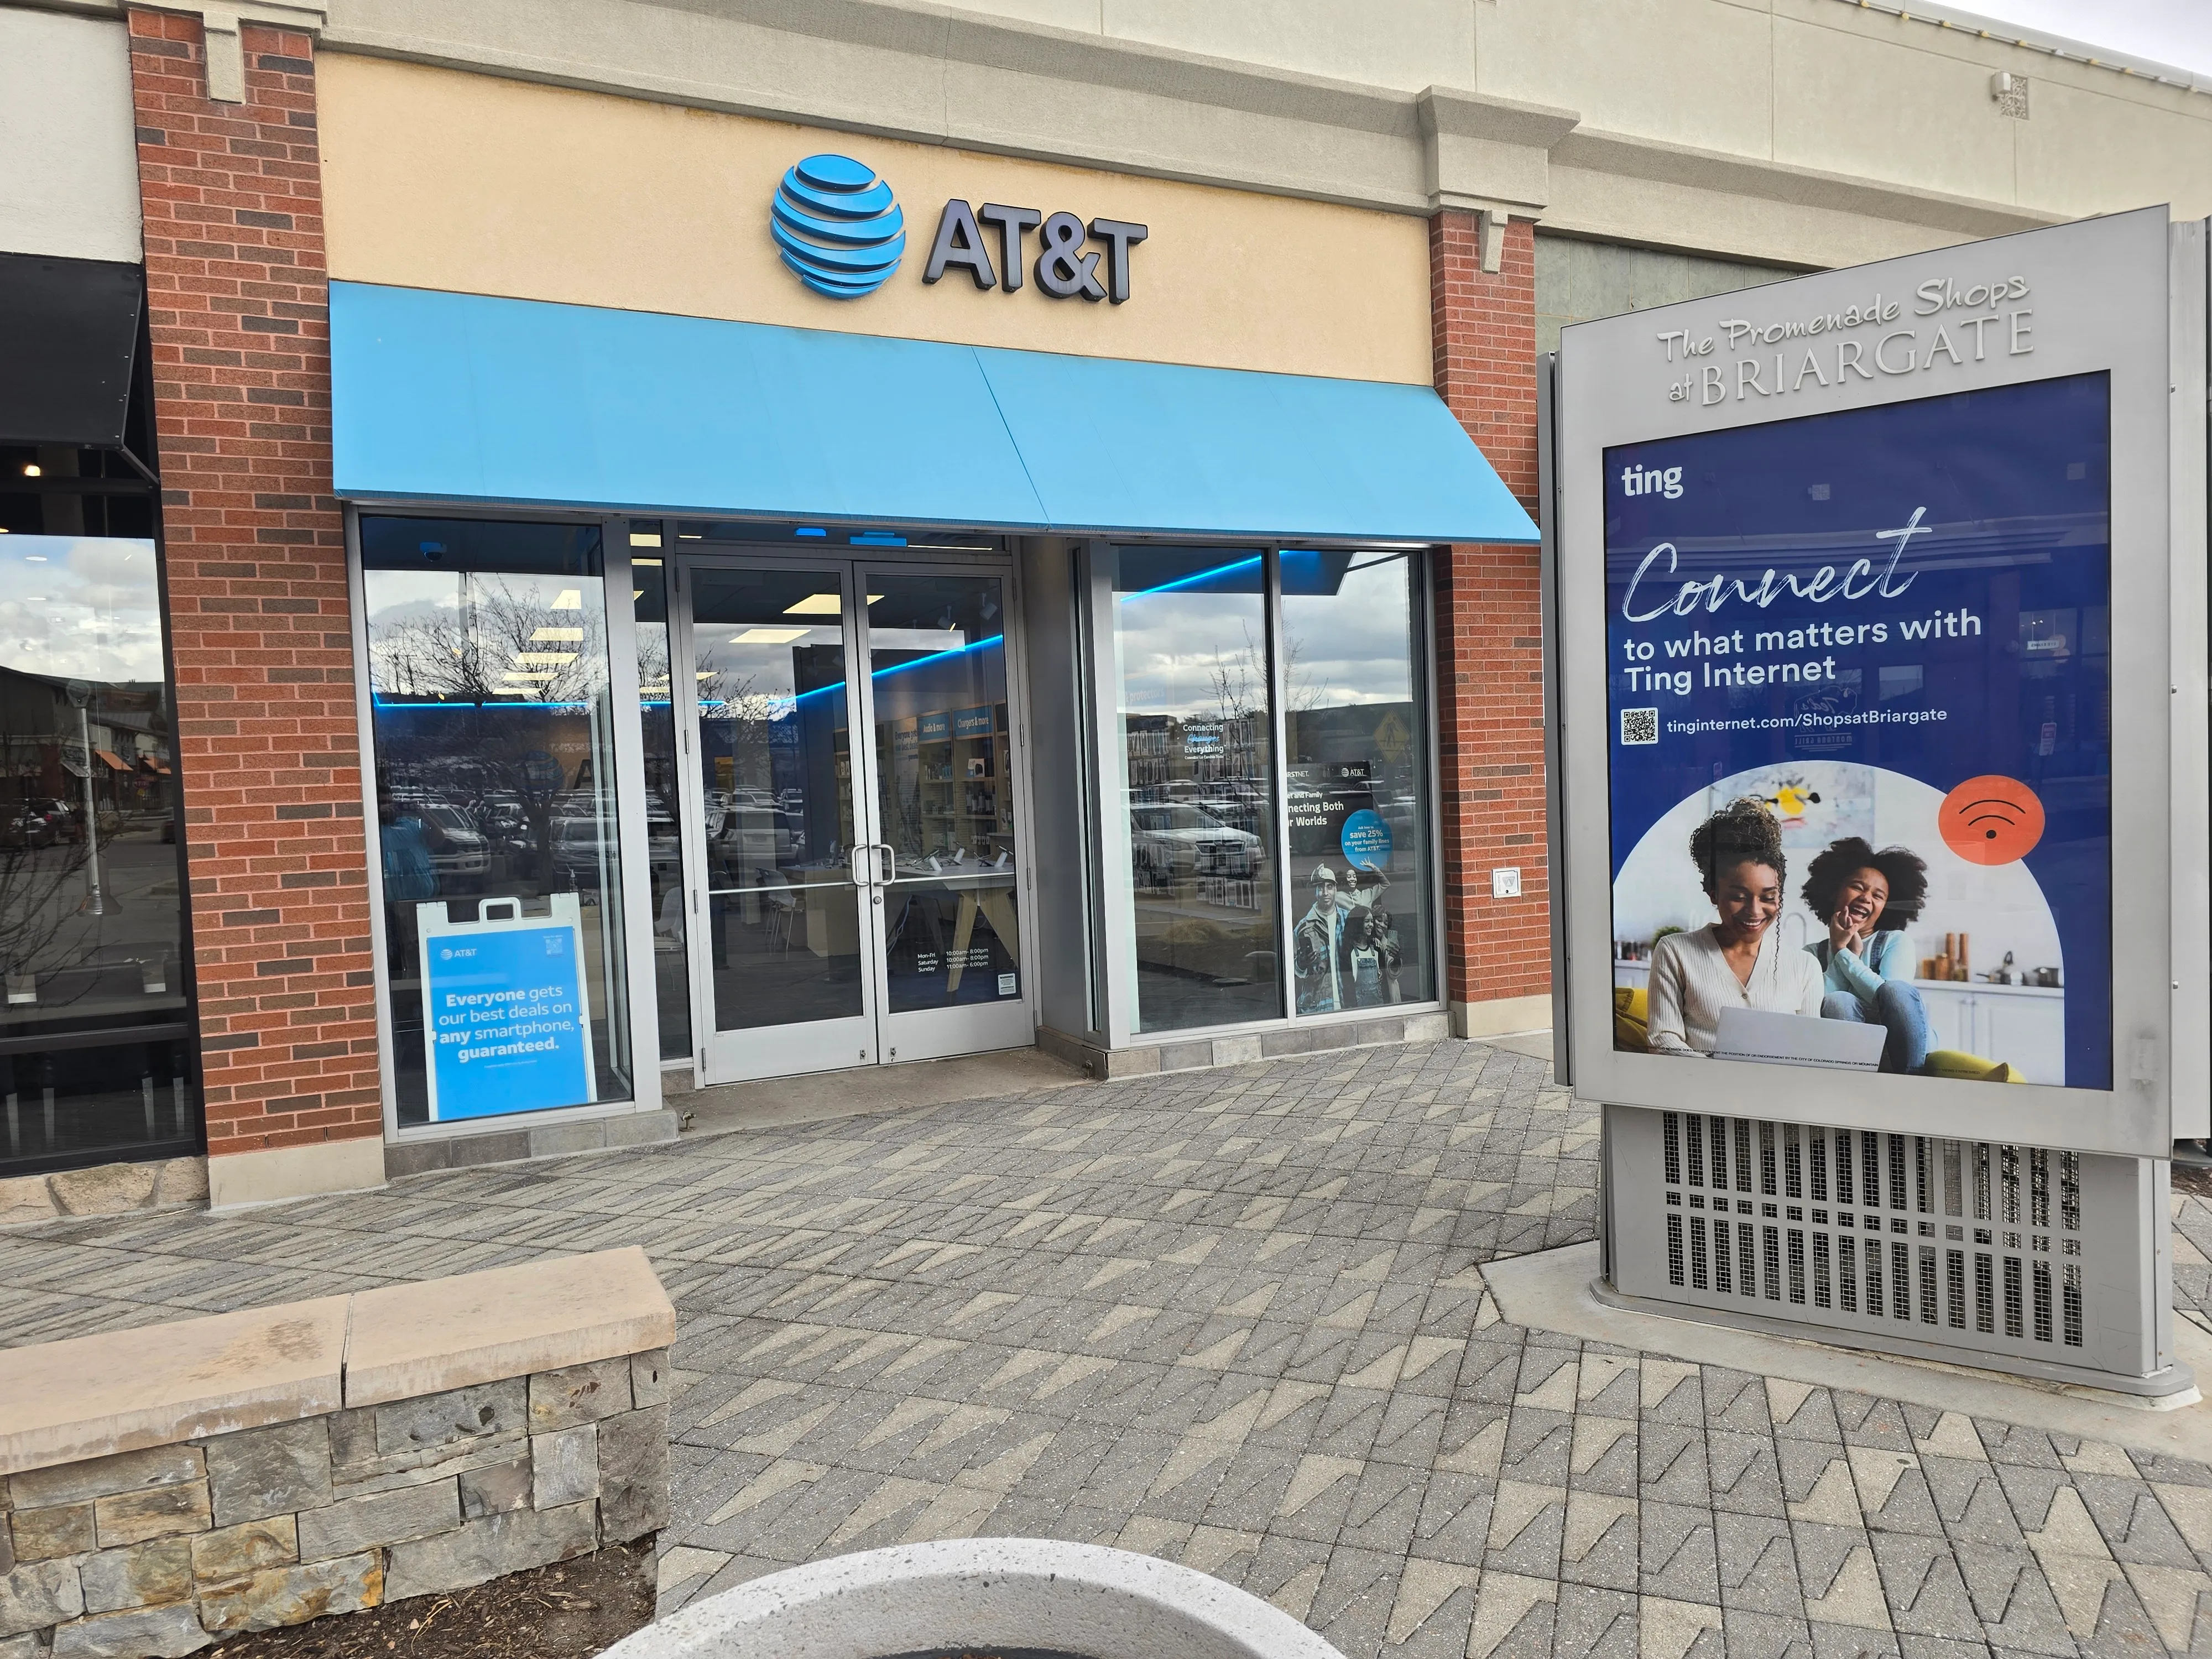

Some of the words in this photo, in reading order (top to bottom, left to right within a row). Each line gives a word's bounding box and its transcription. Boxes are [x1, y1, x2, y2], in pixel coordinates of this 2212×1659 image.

[922, 199, 1147, 304] AT&T
[1657, 329, 1714, 361] The
[1719, 294, 1900, 349] Promenade
[1914, 276, 2030, 316] Shops
[1669, 373, 1693, 402] at
[1702, 309, 2034, 405] BRIARGATE
[1621, 464, 1683, 499] ting
[1622, 506, 1933, 623] Connect
[1624, 638, 1655, 661] to
[1664, 629, 1744, 658] what
[1756, 620, 1888, 651] matters
[1899, 608, 1981, 640] with
[1624, 666, 1692, 696] Ting
[1704, 656, 1836, 688] Internet
[1130, 687, 1165, 705] protectors
[958, 718, 974, 729] Chargers
[978, 717, 989, 726] more
[1183, 723, 1223, 732] Connecting
[1667, 709, 1947, 734] tinginternet.com/ShopsatBriargate
[1185, 745, 1224, 754] Everything
[1288, 803, 1321, 813] necting
[1323, 801, 1344, 811] Both
[1296, 816, 1327, 826] Worlds
[454, 948, 477, 958] AT&T
[446, 990, 525, 1007] Everyone
[529, 985, 563, 1002] gets
[439, 1013, 467, 1026] our
[469, 1008, 506, 1022] best
[508, 1003, 549, 1019] deals
[552, 1003, 572, 1014] on
[440, 1031, 471, 1045] any
[474, 1021, 575, 1040] smartphone,
[458, 1037, 560, 1063] guaranteed.
